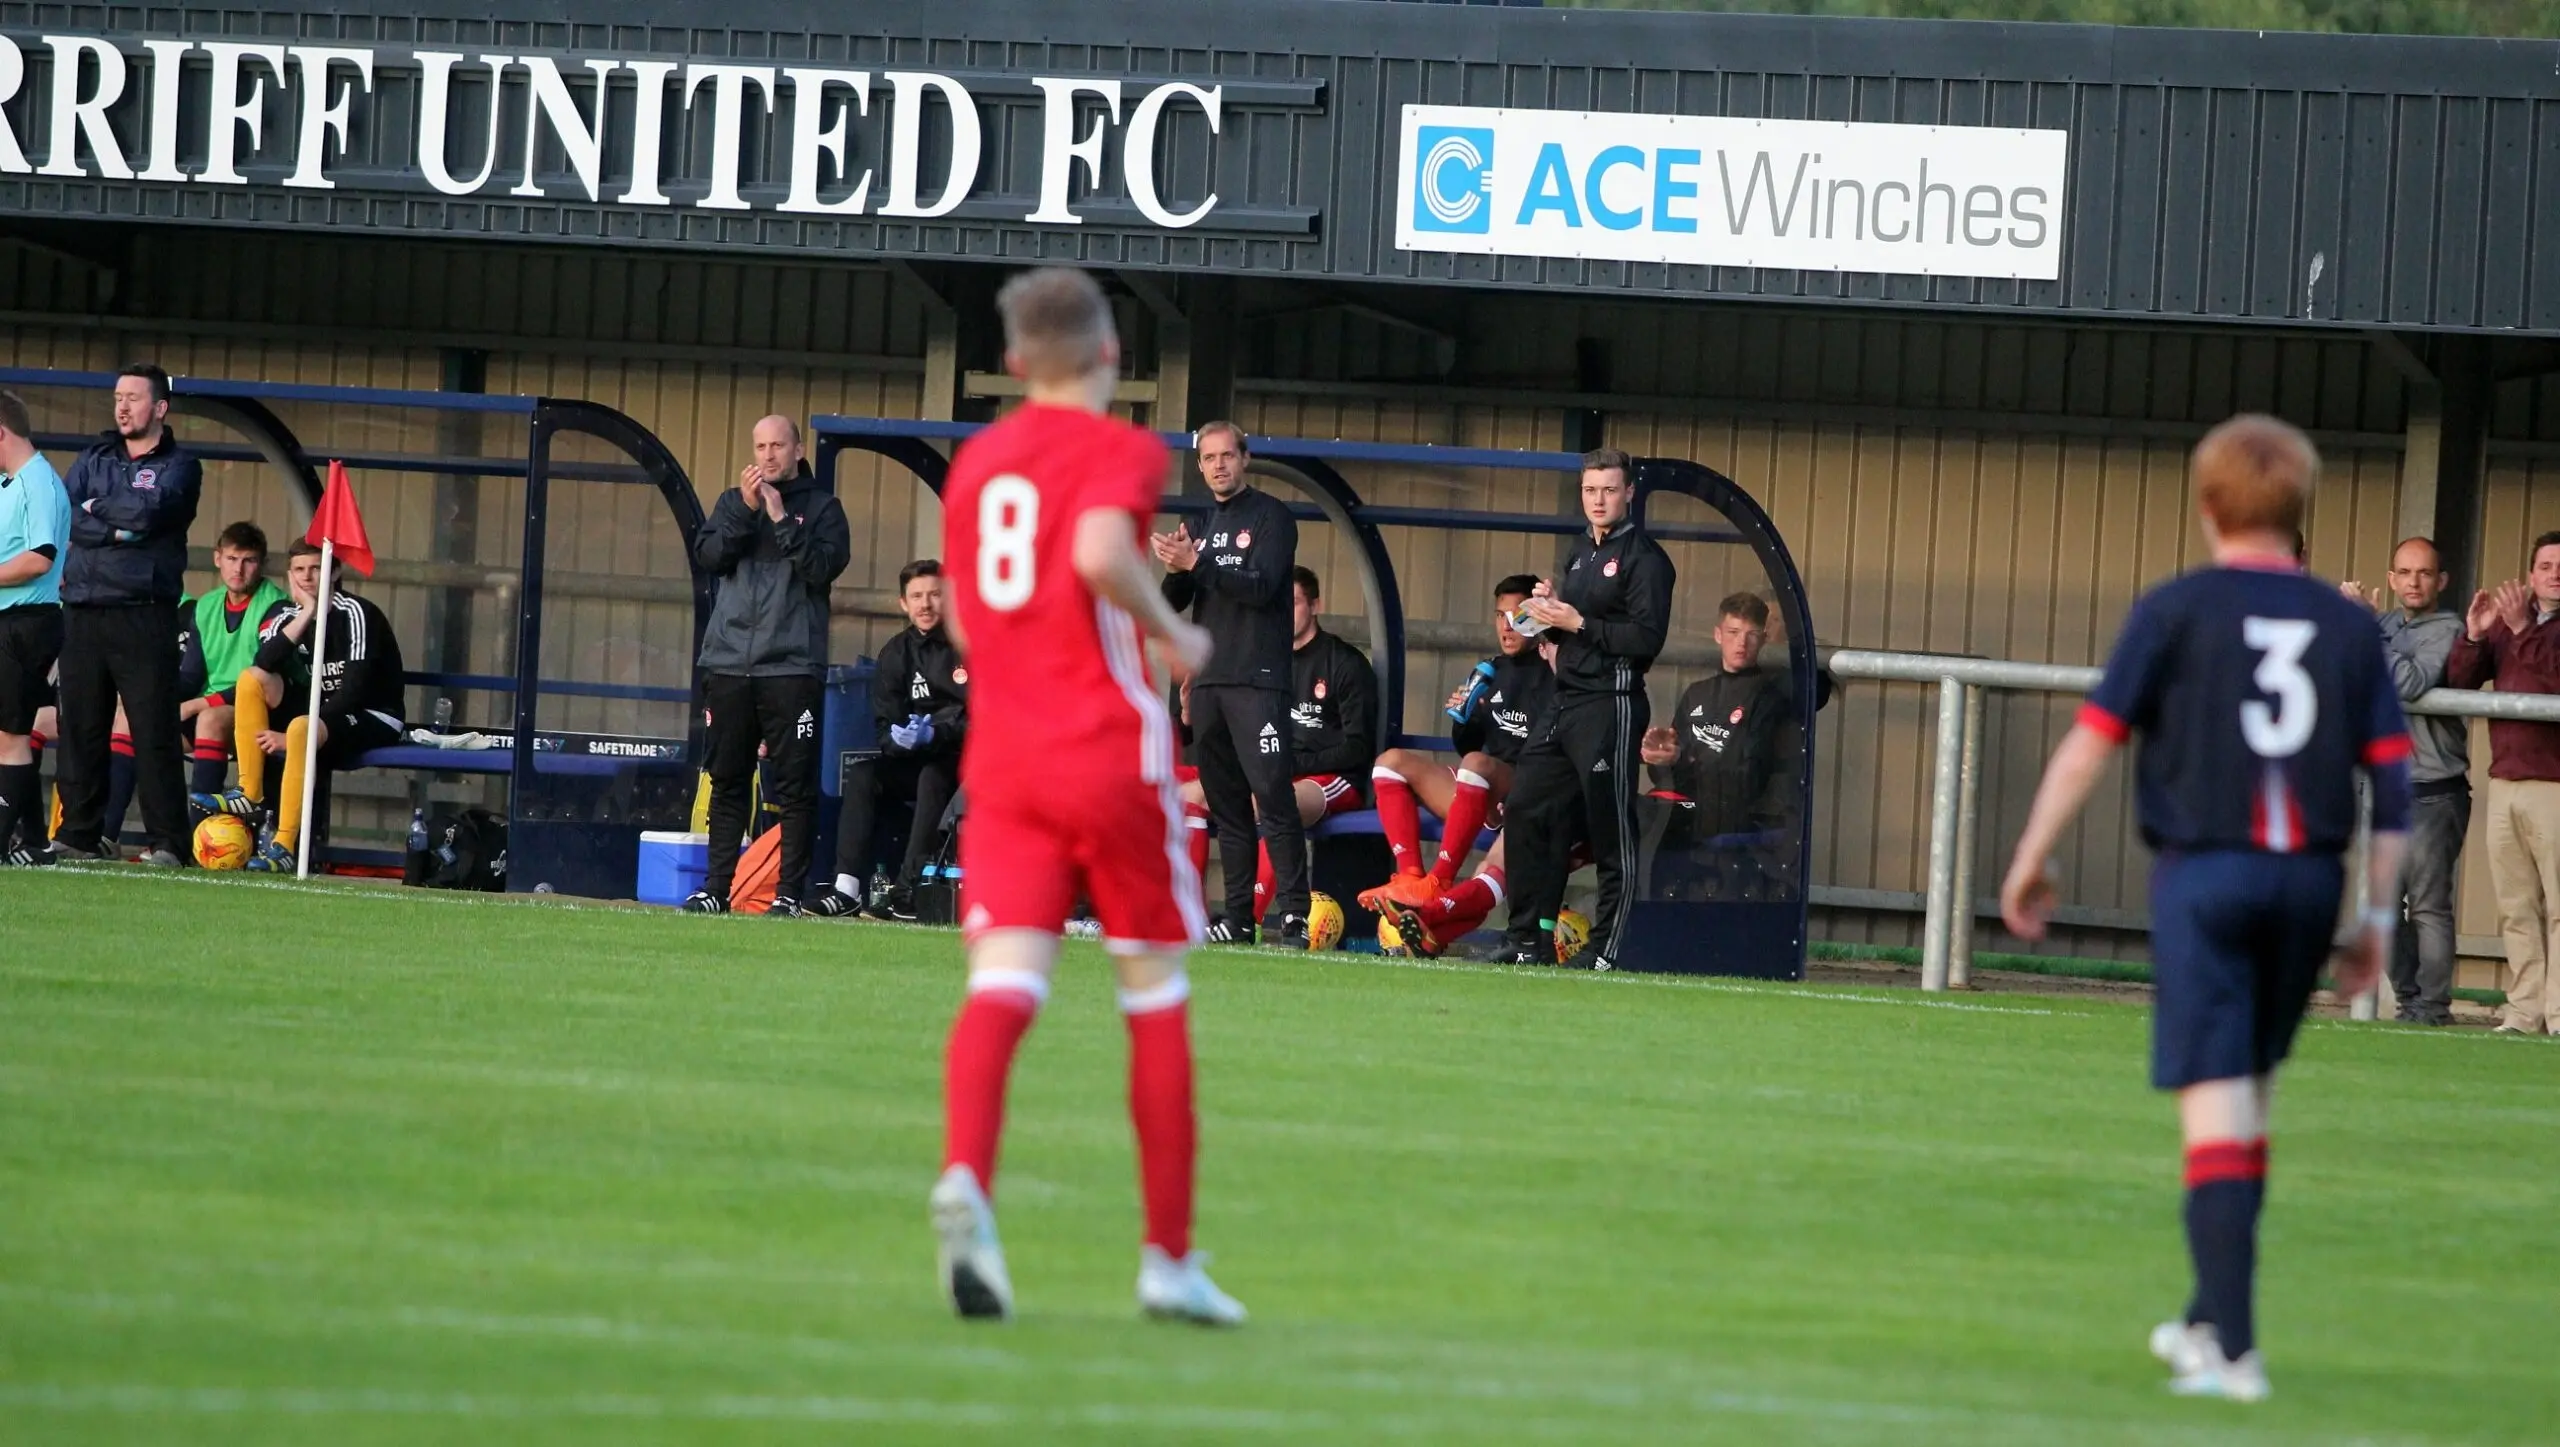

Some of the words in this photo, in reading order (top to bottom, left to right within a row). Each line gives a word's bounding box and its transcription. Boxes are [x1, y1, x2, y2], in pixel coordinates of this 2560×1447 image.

[412, 50, 982, 218] UNITED
[1024, 76, 1222, 229] FC
[1515, 142, 1701, 234] ACE
[1716, 148, 2048, 249] Winches
[977, 472, 1040, 612] 8
[1212, 532, 1229, 548] SA
[2238, 614, 2319, 758] 3
[588, 740, 657, 757] SAFETRADE
[797, 723, 814, 739] PS
[1259, 737, 1280, 753] SA
